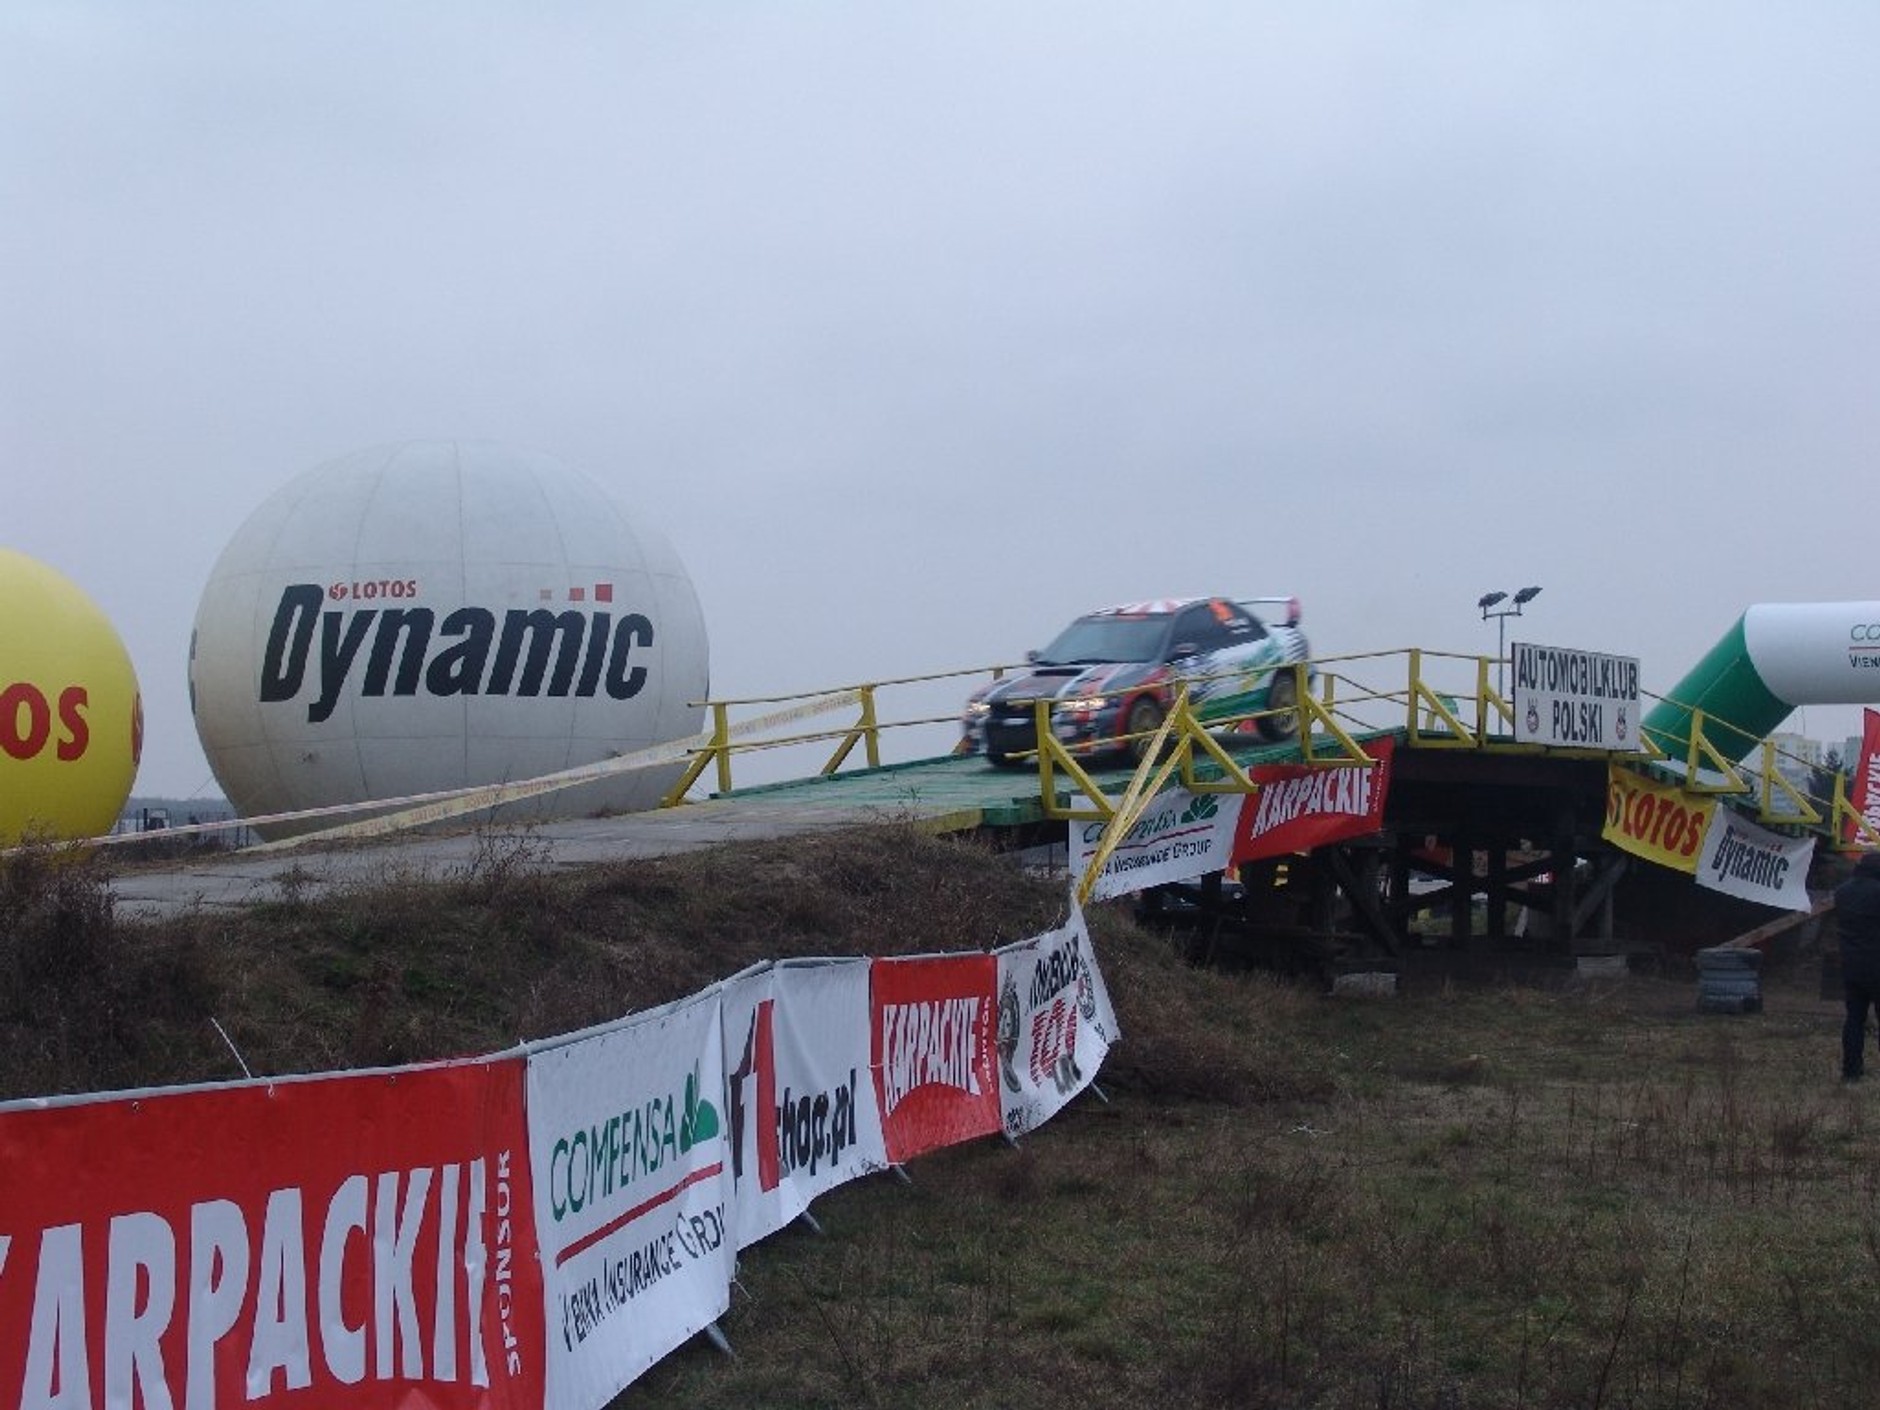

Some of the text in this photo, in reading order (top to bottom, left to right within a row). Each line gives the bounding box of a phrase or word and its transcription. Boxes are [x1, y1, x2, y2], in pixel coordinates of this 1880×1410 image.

[352, 580, 416, 600] LOTOS
[260, 584, 654, 722] Dynamic
[1518, 648, 1637, 700] AUTOMOBILKLUB
[1849, 654, 1880, 668] VIEN
[1553, 700, 1603, 743] POLSKI
[1251, 767, 1372, 840] KARPACKIE
[1623, 788, 1705, 857] LOTOS
[1711, 825, 1790, 890] Dynamic
[883, 997, 981, 1118] KARPACKIE
[551, 1094, 677, 1222] COMPENSA
[0, 1157, 489, 1410] ARPACKIE
